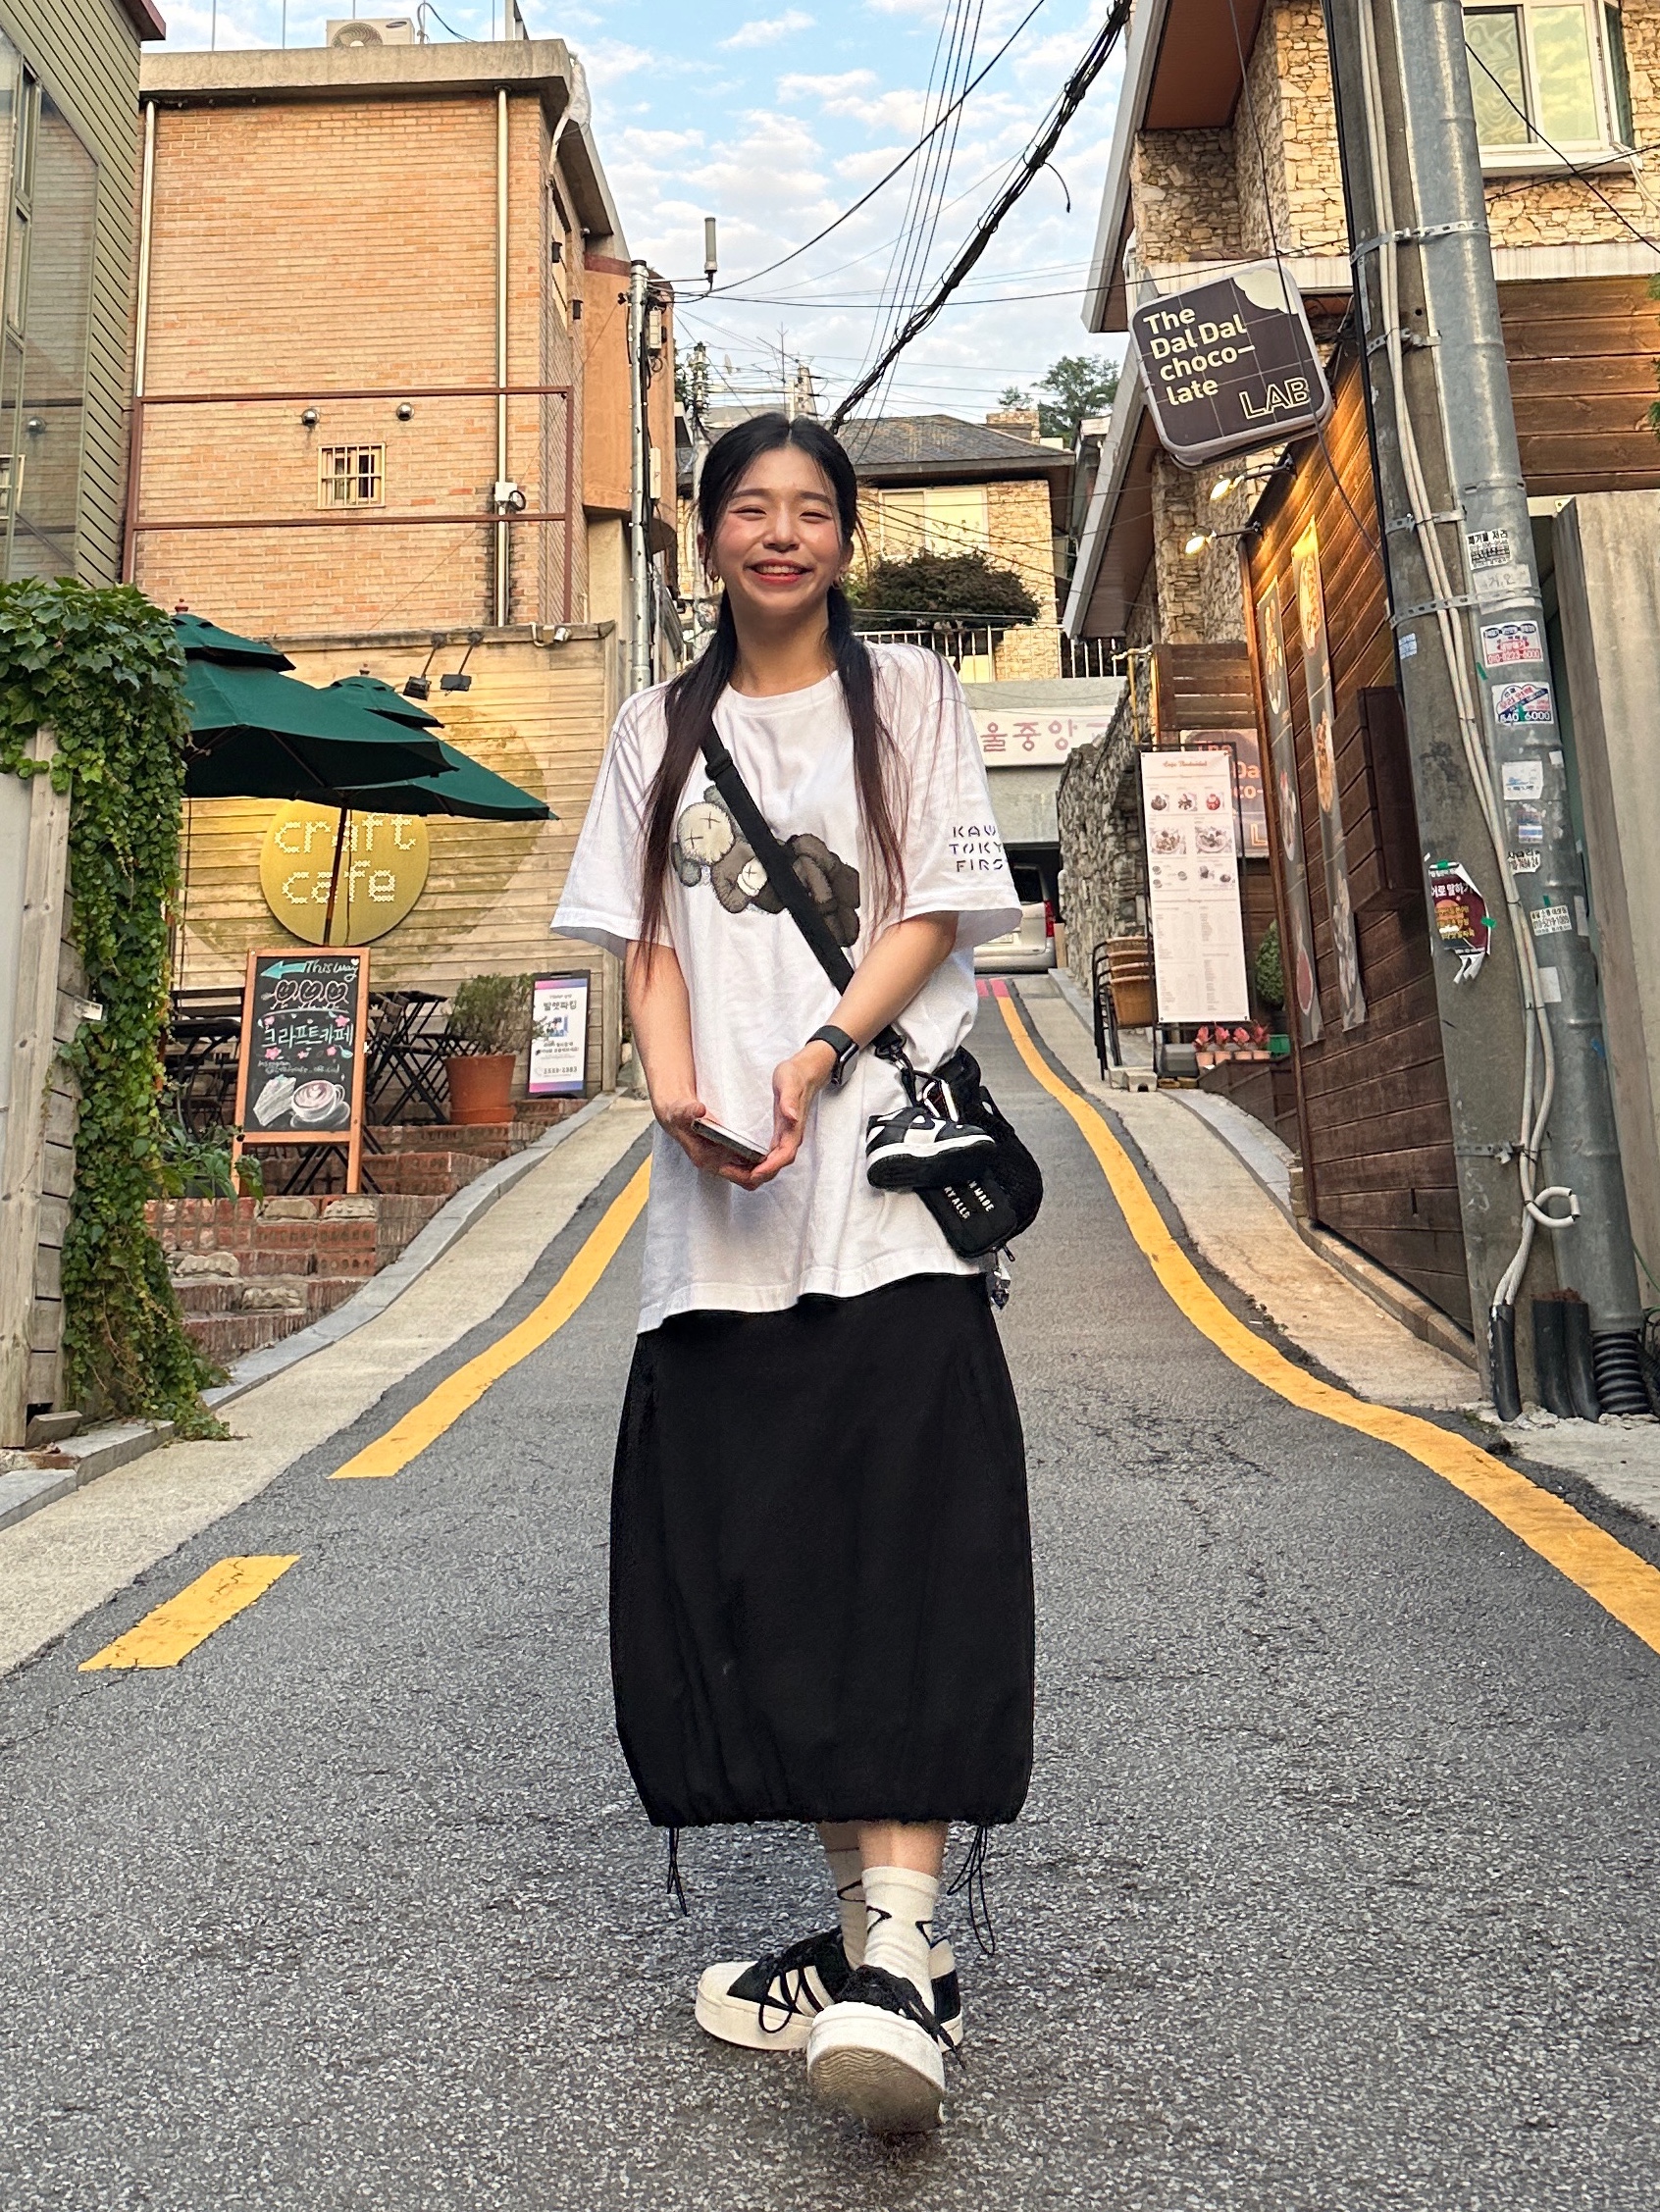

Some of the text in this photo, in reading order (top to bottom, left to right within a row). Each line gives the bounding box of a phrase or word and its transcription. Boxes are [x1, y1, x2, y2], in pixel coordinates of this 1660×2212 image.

[1143, 307, 1196, 334] The
[1149, 314, 1248, 360] Dal Dal
[1166, 379, 1219, 406] late
[1238, 377, 1311, 420] LAB
[275, 812, 416, 853] craft
[282, 860, 395, 903] cafe
[304, 959, 358, 981] This way
[261, 1023, 354, 1049] 크라프트카페
